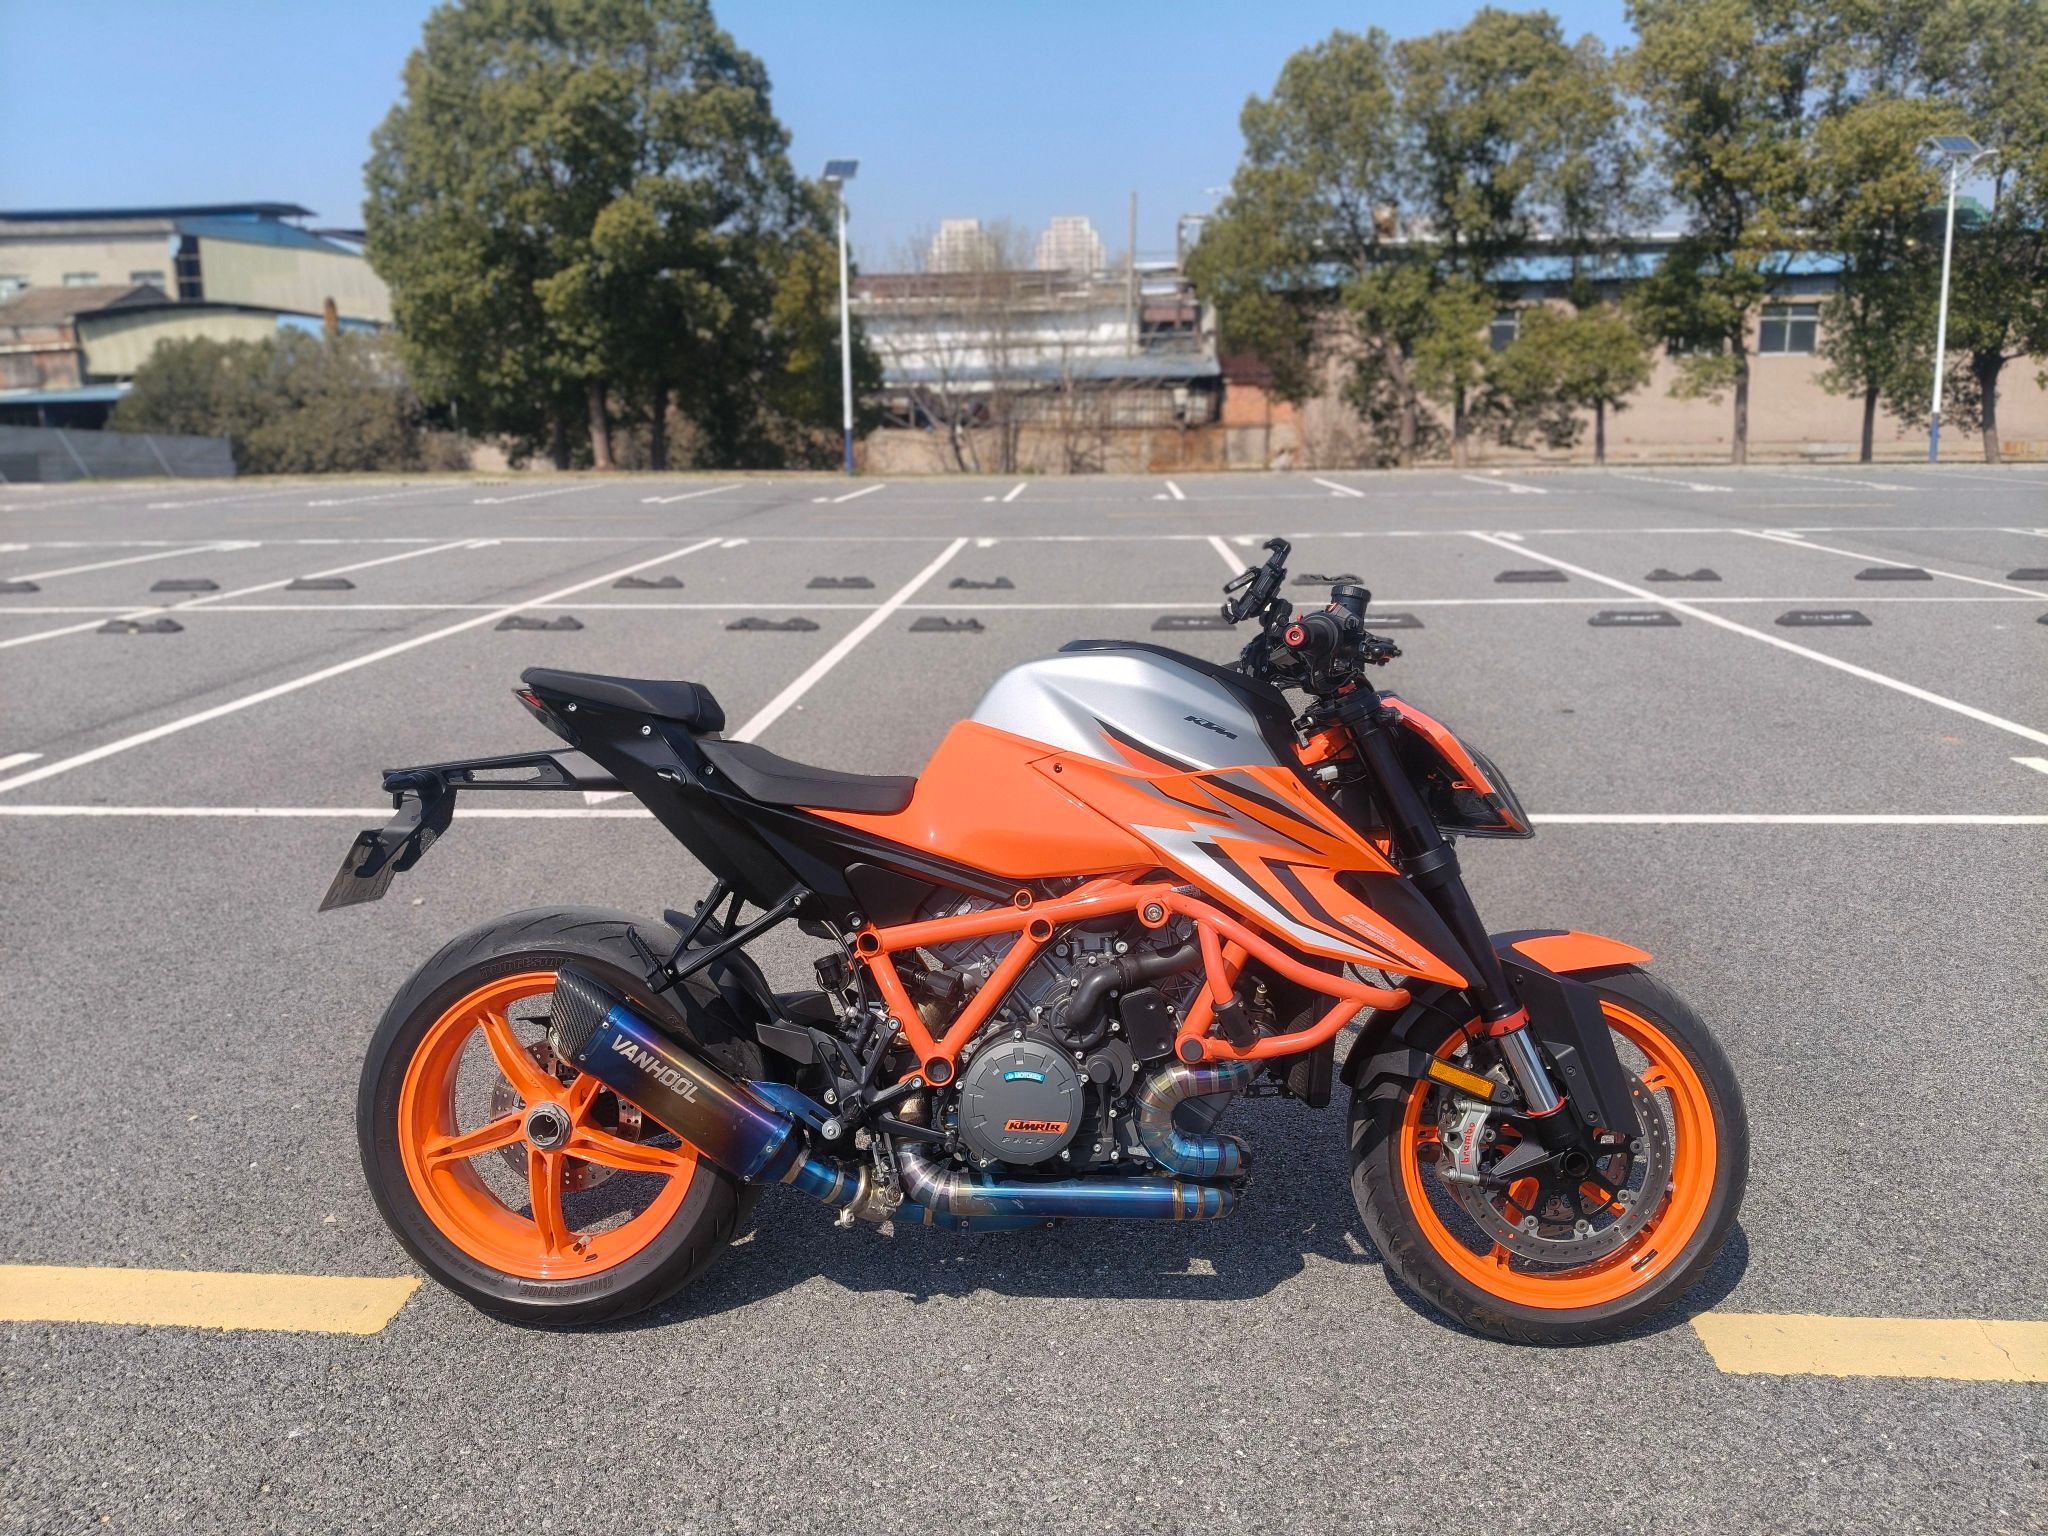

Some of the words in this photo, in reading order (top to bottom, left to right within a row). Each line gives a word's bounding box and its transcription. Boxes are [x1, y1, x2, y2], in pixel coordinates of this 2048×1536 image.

[1184, 715, 1238, 740] KTM
[611, 1033, 699, 1104] VANHOOL
[1460, 1122, 1476, 1165] brembo
